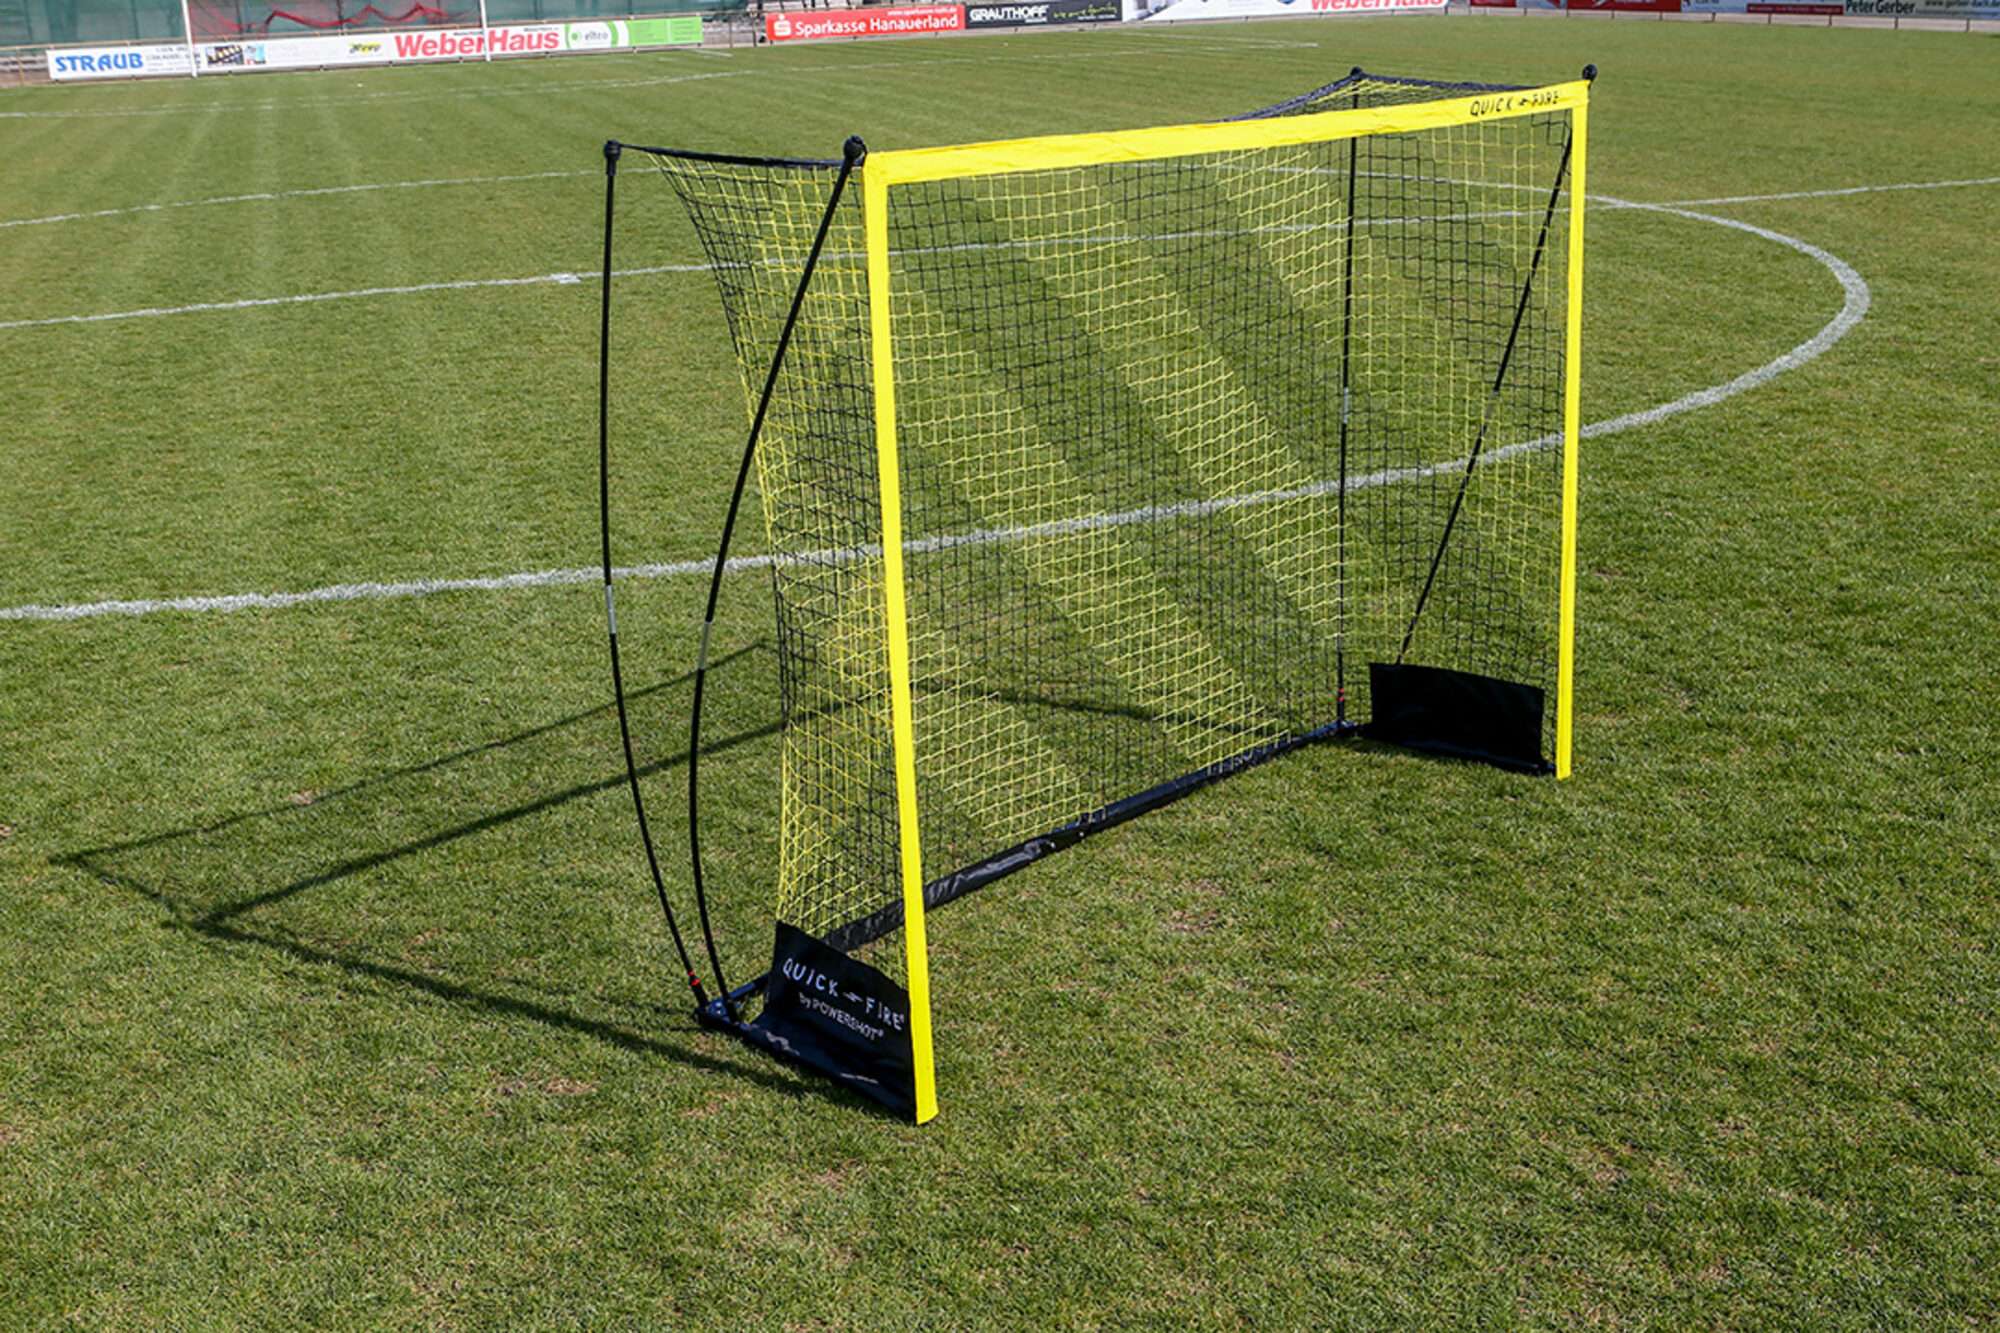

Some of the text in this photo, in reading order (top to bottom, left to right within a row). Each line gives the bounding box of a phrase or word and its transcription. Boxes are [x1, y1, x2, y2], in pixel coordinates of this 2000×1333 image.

[969, 5, 1049, 21] GRAUTHOFF
[795, 14, 958, 37] Sparkasse Hanauerland
[394, 29, 560, 58] WeberHaus
[55, 53, 144, 72] STRAUB
[782, 958, 838, 997] QUICK
